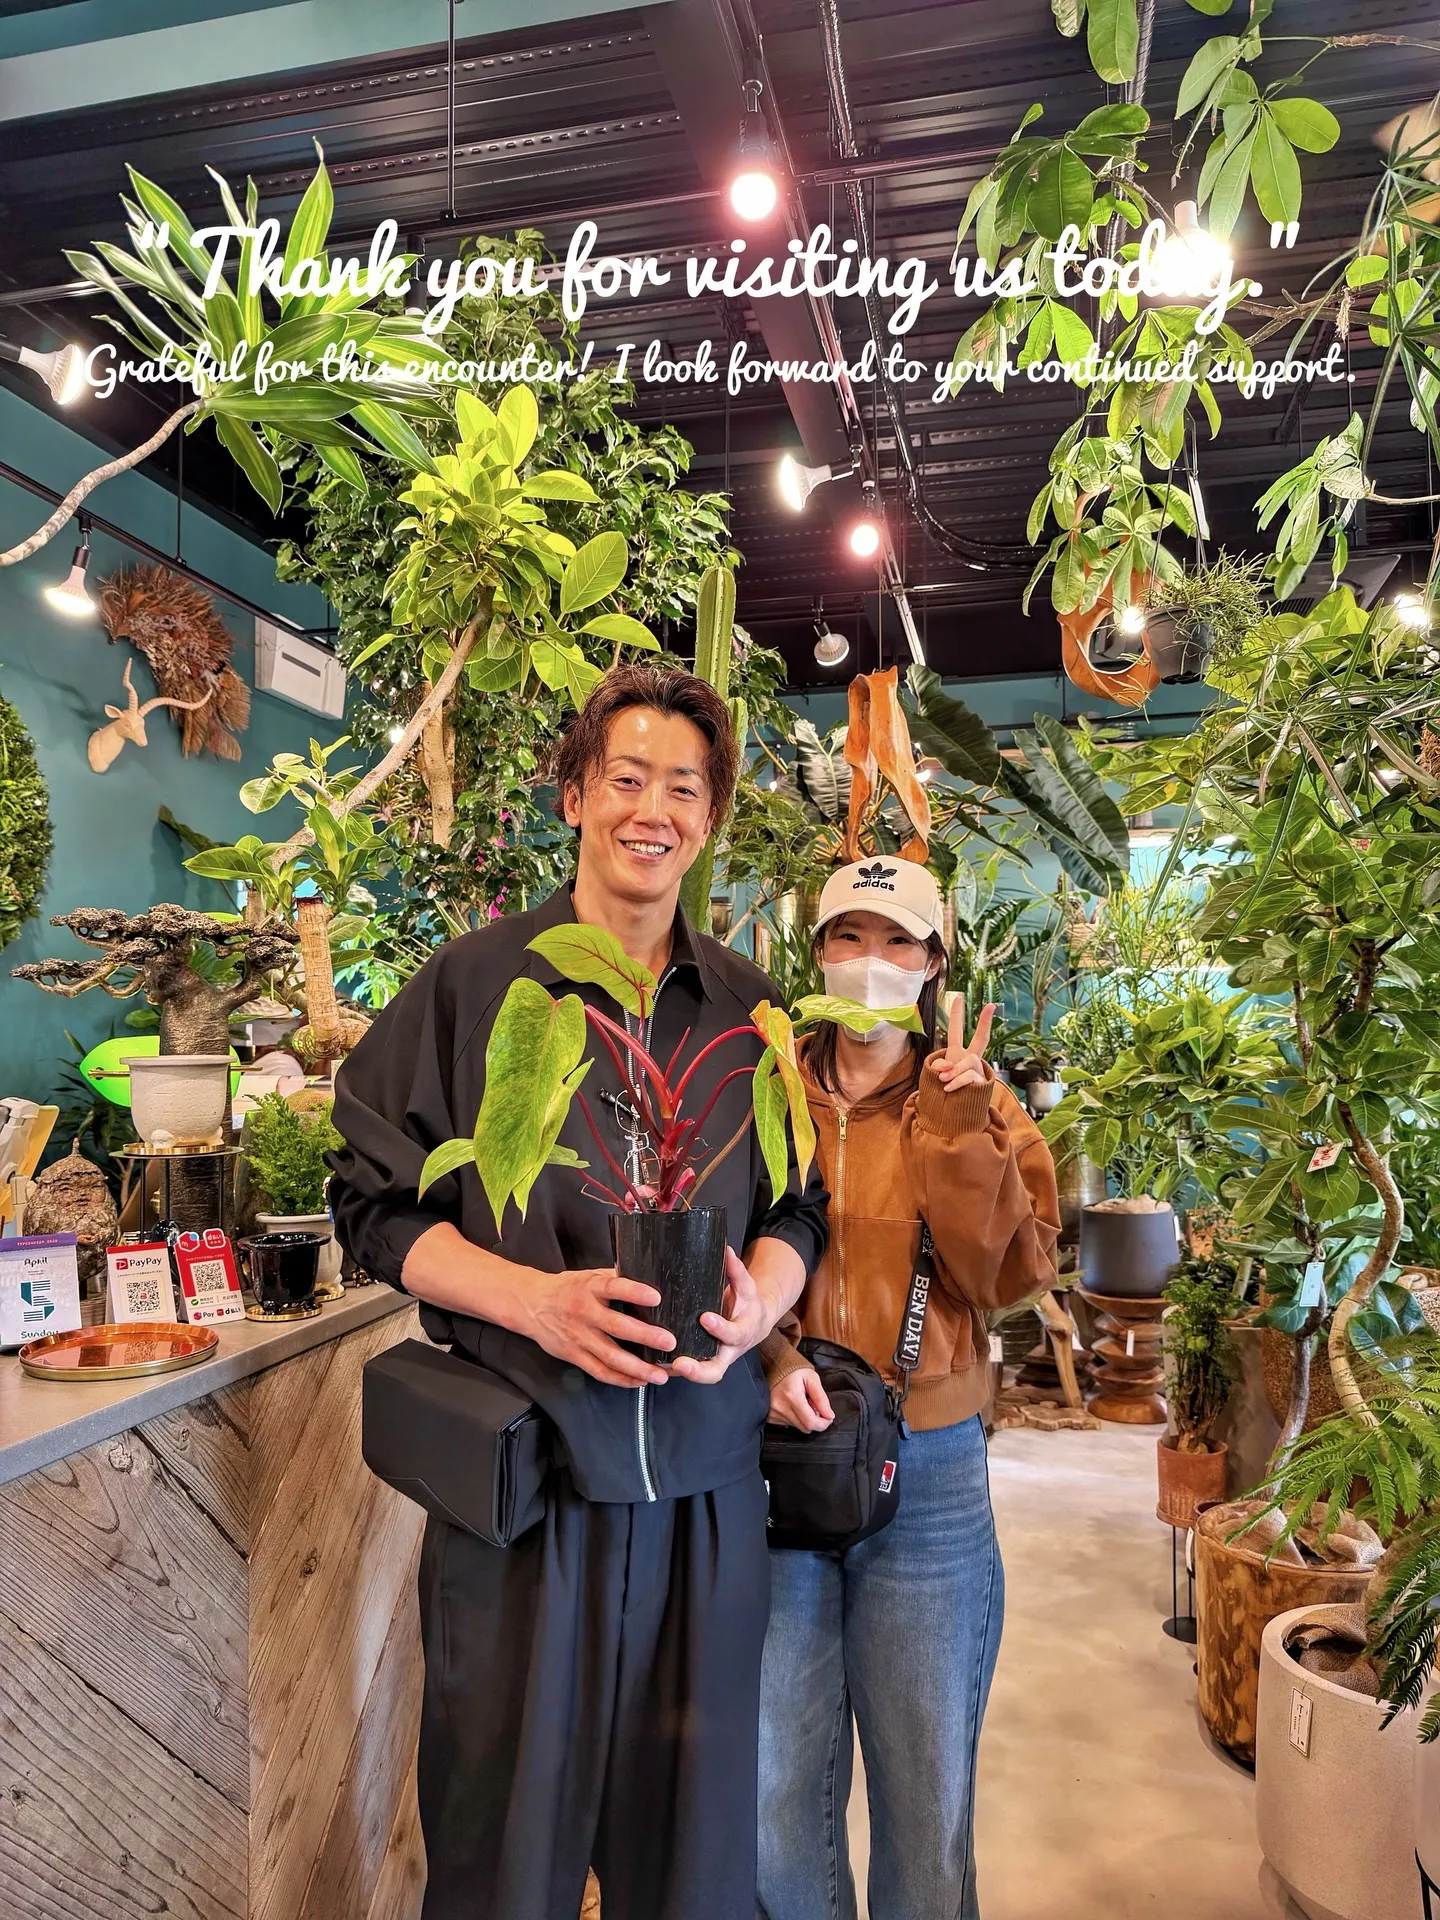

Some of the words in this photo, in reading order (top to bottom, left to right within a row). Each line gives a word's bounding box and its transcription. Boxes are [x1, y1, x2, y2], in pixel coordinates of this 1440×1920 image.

[852, 879, 895, 892] adidas
[129, 1257, 162, 1268] PayPay
[910, 1274, 930, 1317] BEN
